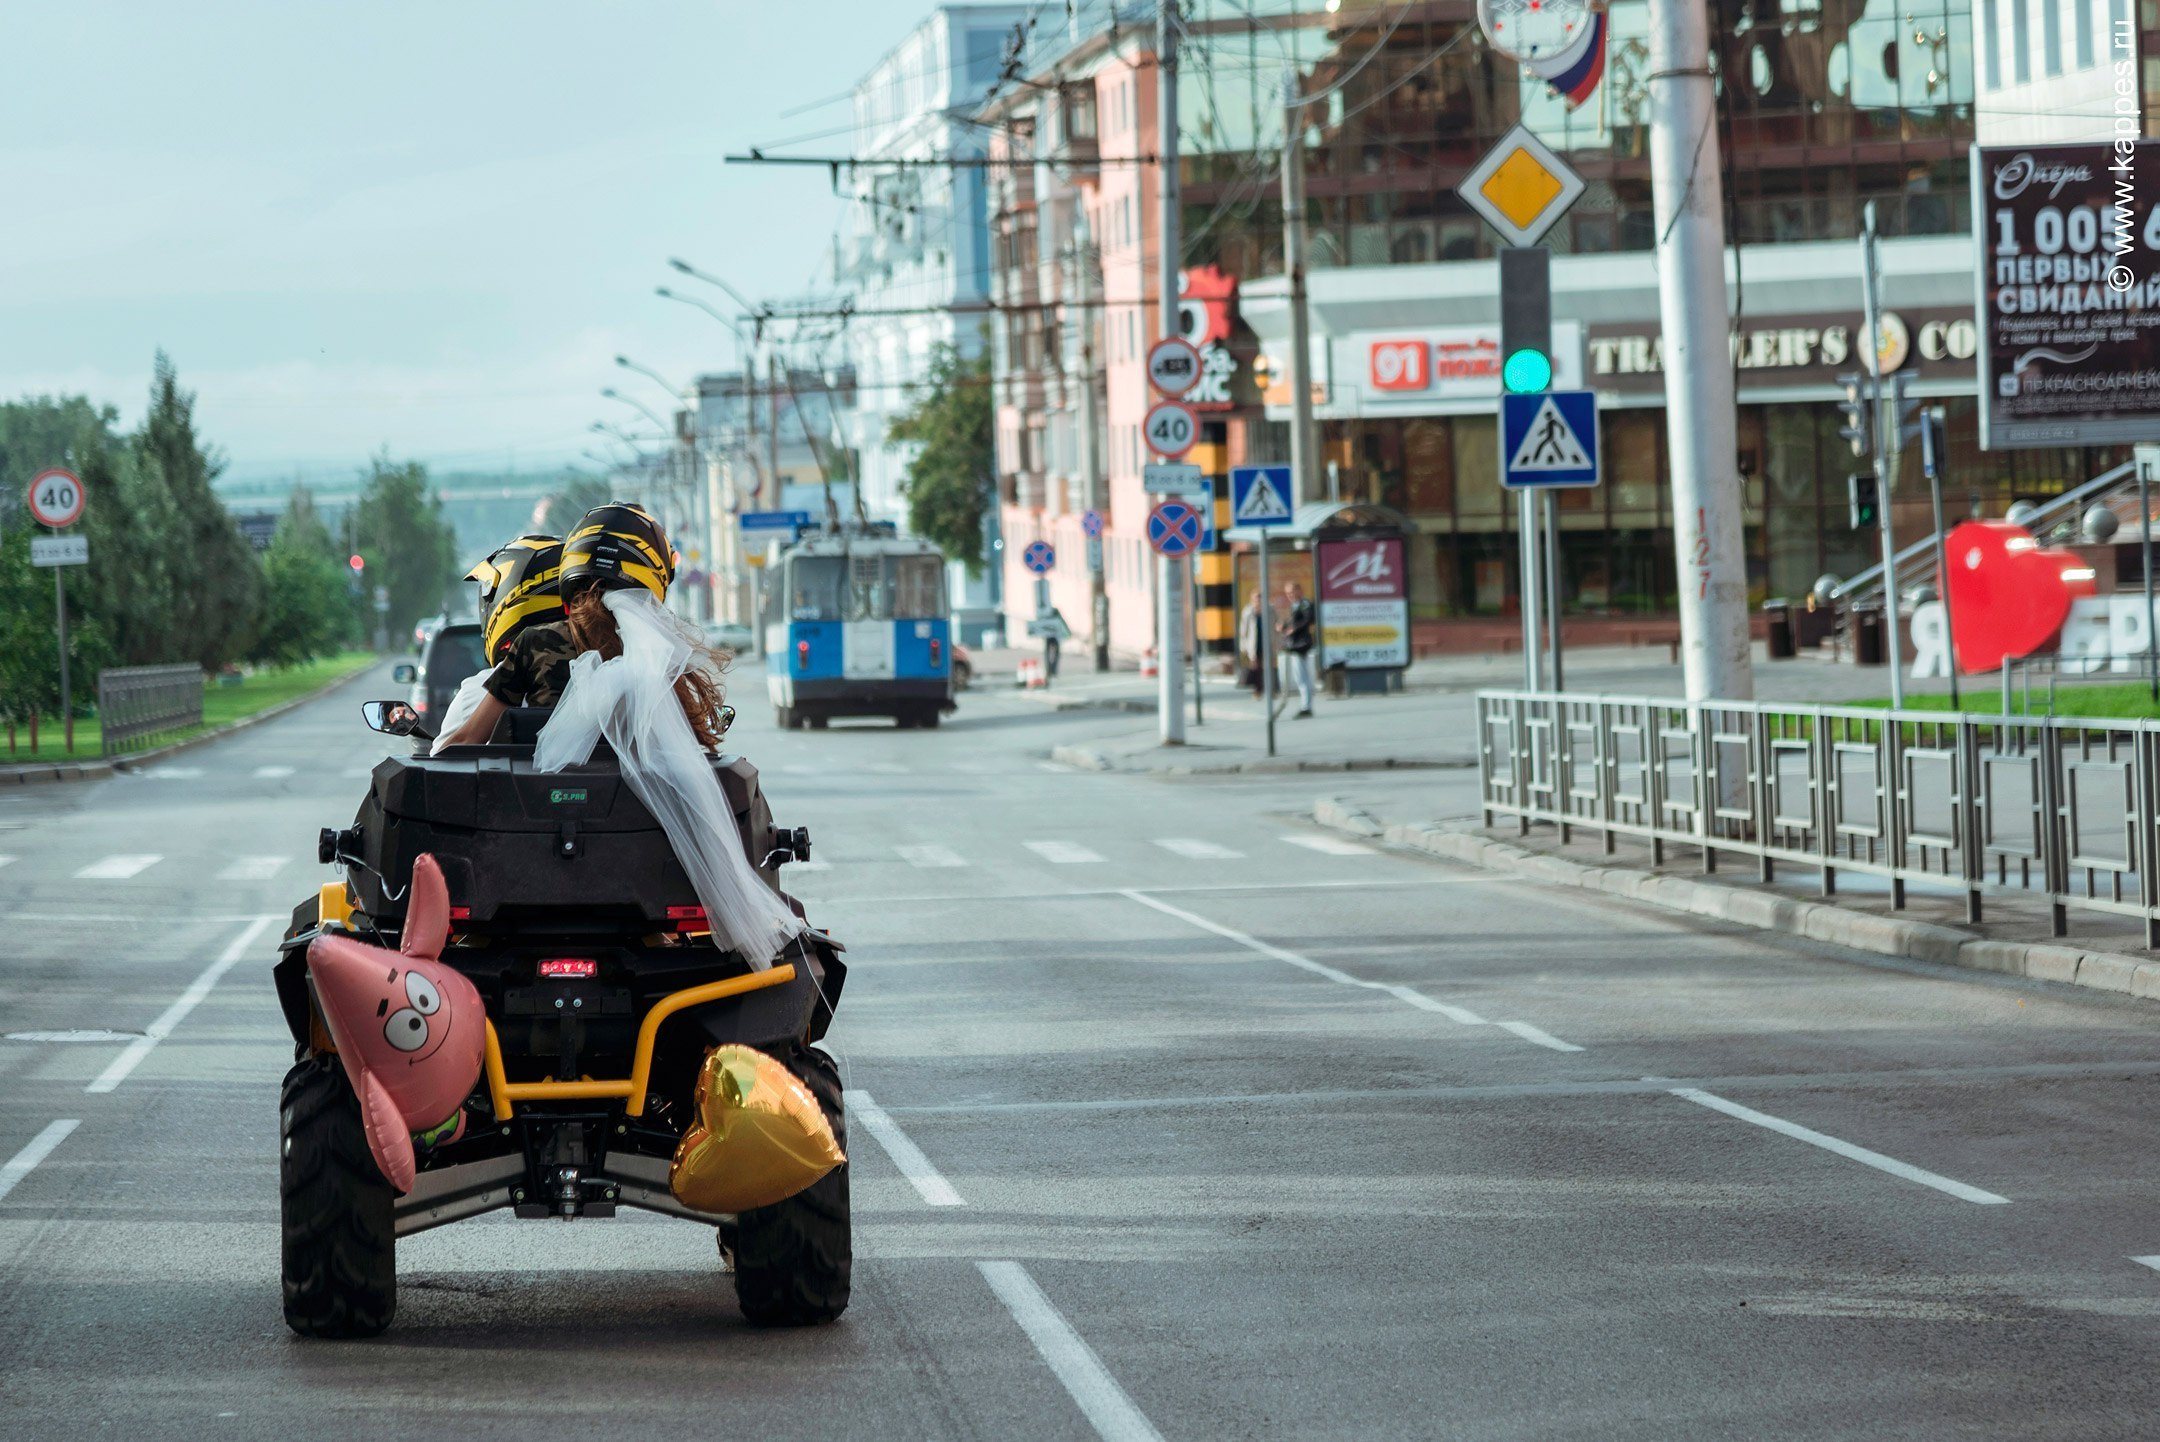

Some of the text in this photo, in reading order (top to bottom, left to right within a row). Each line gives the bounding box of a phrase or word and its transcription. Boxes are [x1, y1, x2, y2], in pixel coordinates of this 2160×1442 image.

[1994, 153, 2094, 200] Опера
[1996, 207, 2021, 256] 1
[2034, 205, 2128, 255] 005
[1996, 253, 2120, 285] ПЕРВЫХ
[1153, 417, 1191, 443] 40
[41, 486, 73, 510] 40
[1910, 601, 1951, 679] Я
